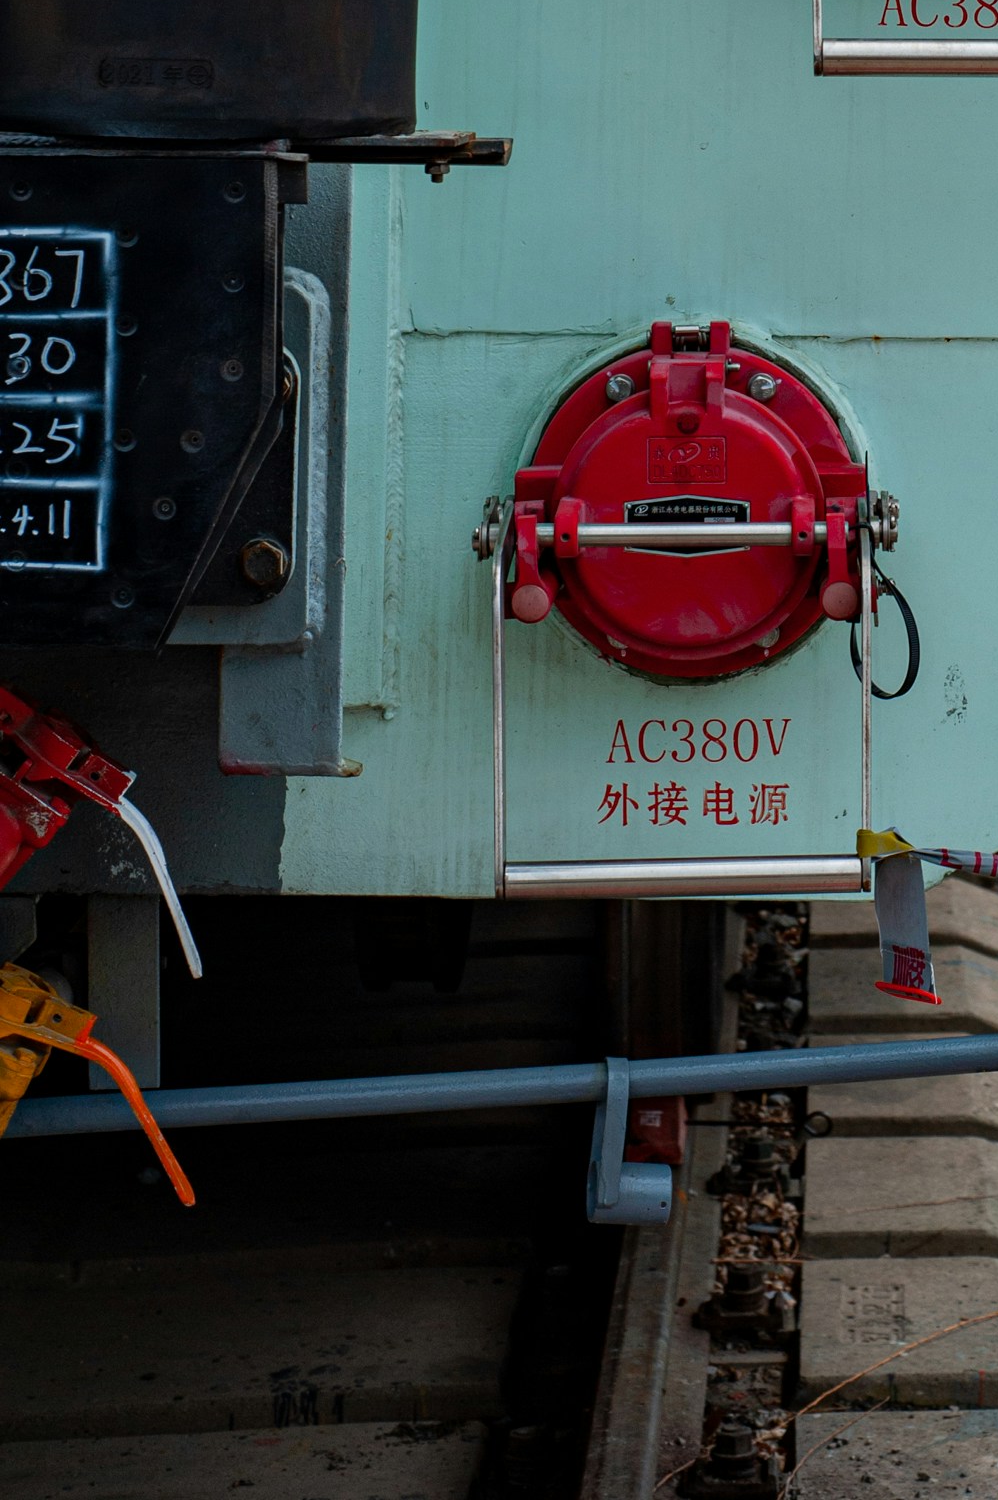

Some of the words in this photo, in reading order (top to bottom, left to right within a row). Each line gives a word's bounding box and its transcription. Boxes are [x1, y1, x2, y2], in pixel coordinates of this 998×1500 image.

[605, 718, 792, 764] AC380V
[597, 780, 790, 827] 外接电源
